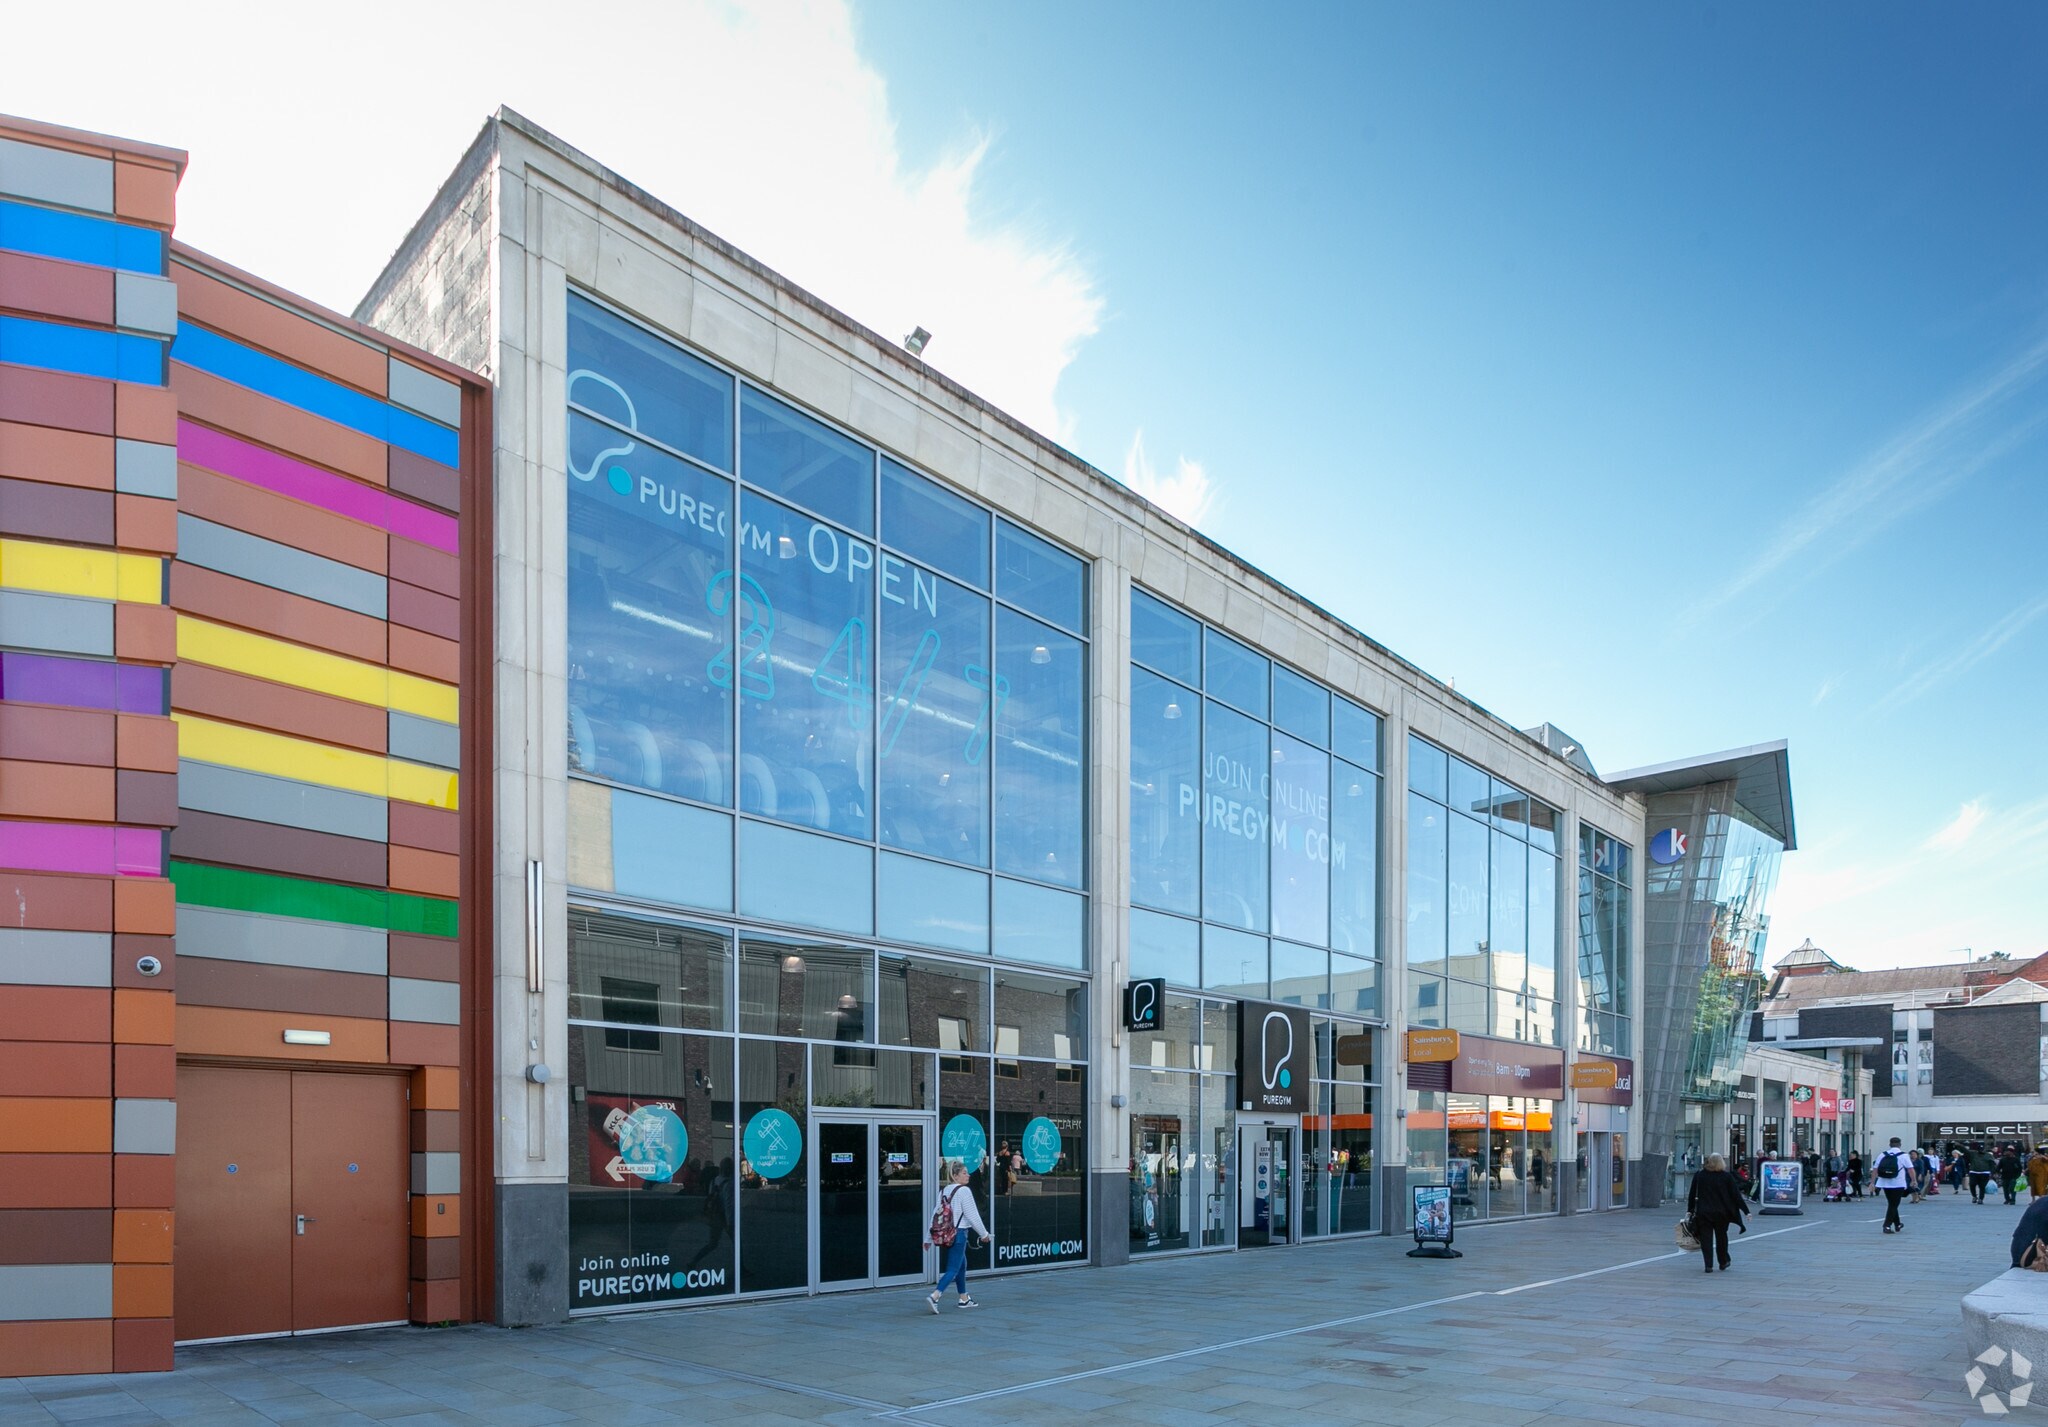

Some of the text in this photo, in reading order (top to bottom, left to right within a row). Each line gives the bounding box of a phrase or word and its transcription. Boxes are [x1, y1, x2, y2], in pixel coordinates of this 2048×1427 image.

[807, 523, 937, 618] OPEN
[1204, 752, 1251, 793] JOIN
[1413, 1048, 1432, 1057] Local
[1262, 1094, 1292, 1105] PUREGYM
[947, 1128, 981, 1151] 24/7
[579, 1252, 670, 1271] Join online
